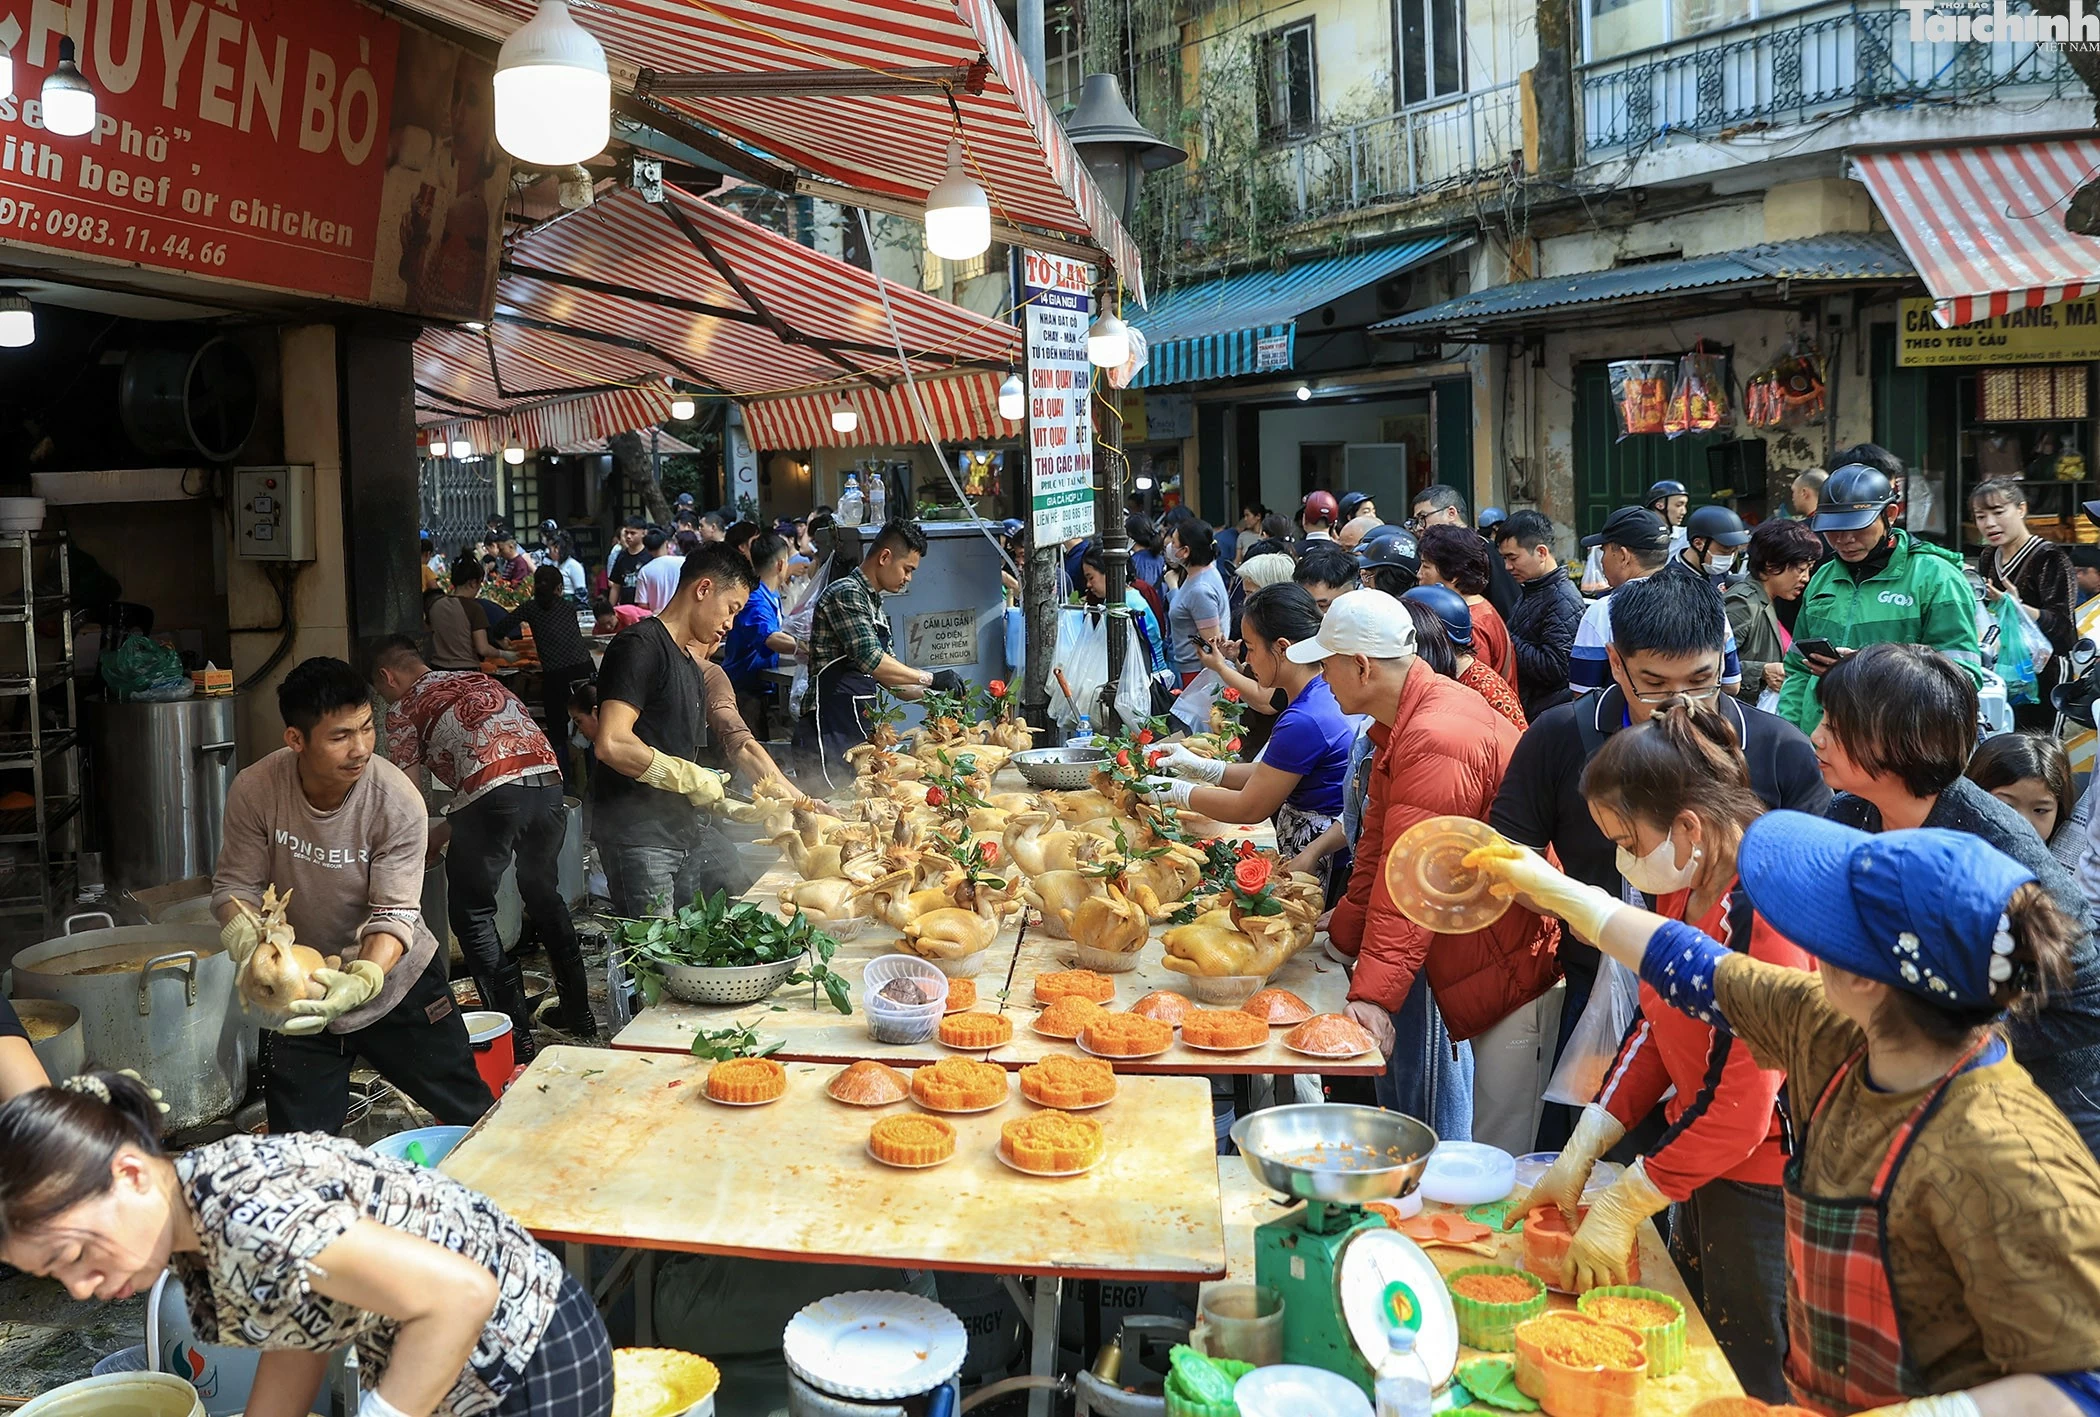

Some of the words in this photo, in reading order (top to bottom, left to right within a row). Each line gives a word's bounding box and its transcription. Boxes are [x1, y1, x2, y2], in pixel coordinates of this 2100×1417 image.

[0, 0, 289, 144] HUYÊN
[299, 36, 379, 166] BÒ
[0, 134, 63, 182] ith
[78, 155, 170, 207] beef
[181, 187, 219, 217] or
[229, 198, 353, 248] chicken
[200, 240, 226, 266] 66
[2066, 298, 2098, 326] MÃ
[1043, 330, 1058, 343] CHAY
[1905, 338, 1942, 349] THEO
[1946, 336, 1973, 347] YÊU
[1032, 368, 1054, 389] CHIM
[1055, 369, 1073, 391] QUAY
[1033, 394, 1045, 418] GÀ
[1046, 398, 1064, 419] QUAY
[1033, 427, 1048, 451] VỊT
[1049, 426, 1067, 448] QUAY
[1076, 422, 1087, 446] BỆT
[1056, 453, 1073, 474] CÁC
[1036, 511, 1050, 527] LIÊN
[923, 615, 940, 629] CẤM
[941, 618, 953, 630] LẠI
[929, 651, 948, 661] CHẾT
[931, 641, 950, 651] NGUY
